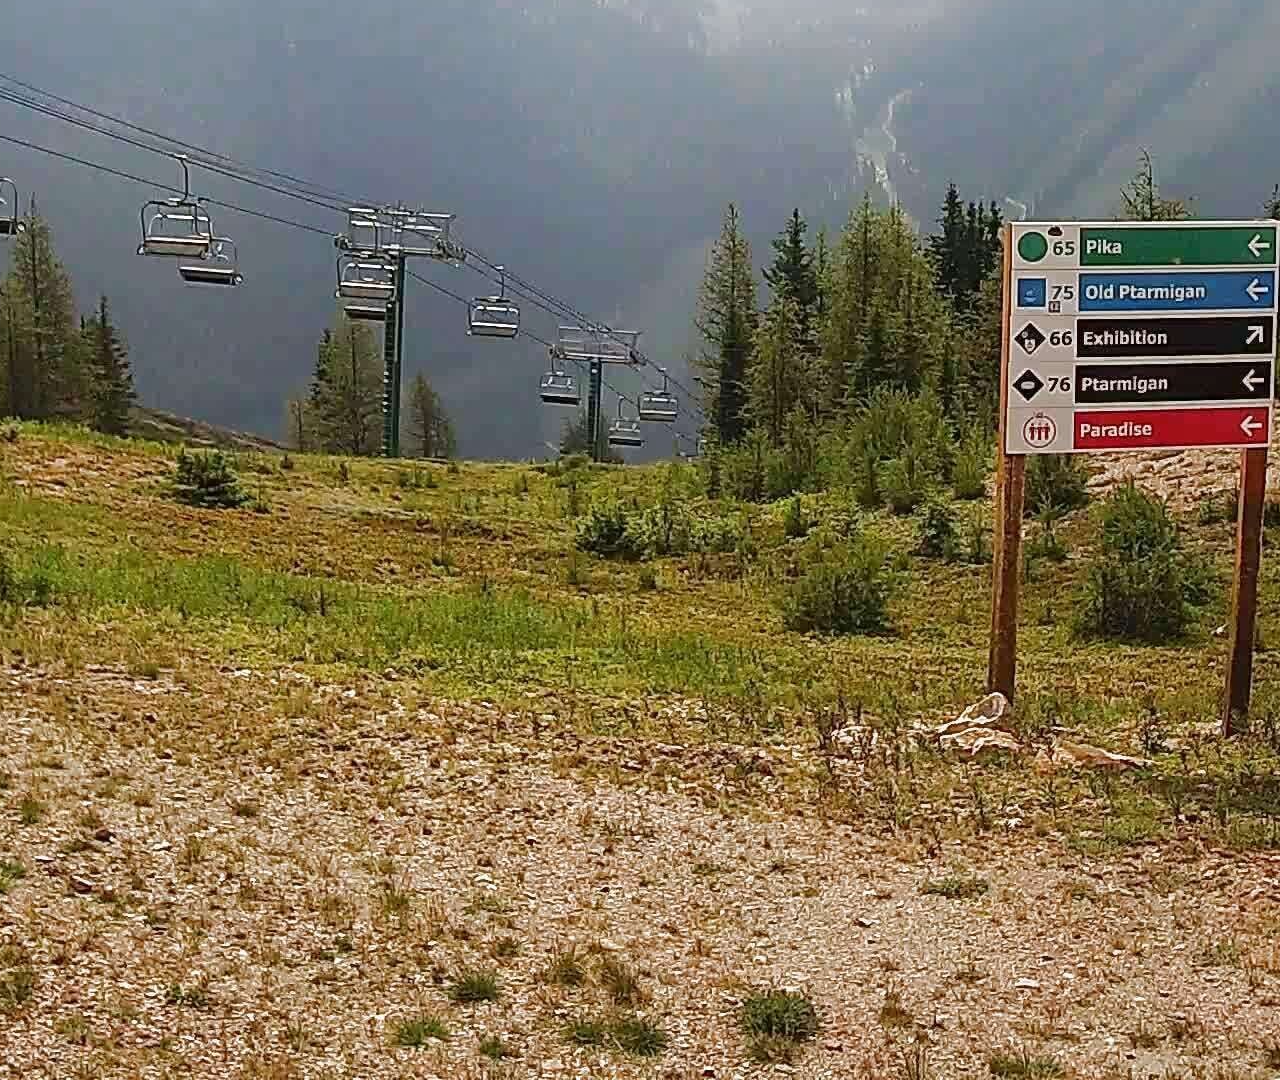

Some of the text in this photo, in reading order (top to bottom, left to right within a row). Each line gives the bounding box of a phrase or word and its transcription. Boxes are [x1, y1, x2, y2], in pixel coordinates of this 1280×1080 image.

[1052, 239, 1122, 256] 65 Pika
[1051, 284, 1206, 302] 75 Old Ptarmigan
[1049, 331, 1168, 346] 66 Exhibition
[1047, 375, 1168, 394] 76 Ptarmigan
[1080, 422, 1152, 438] Paradise
